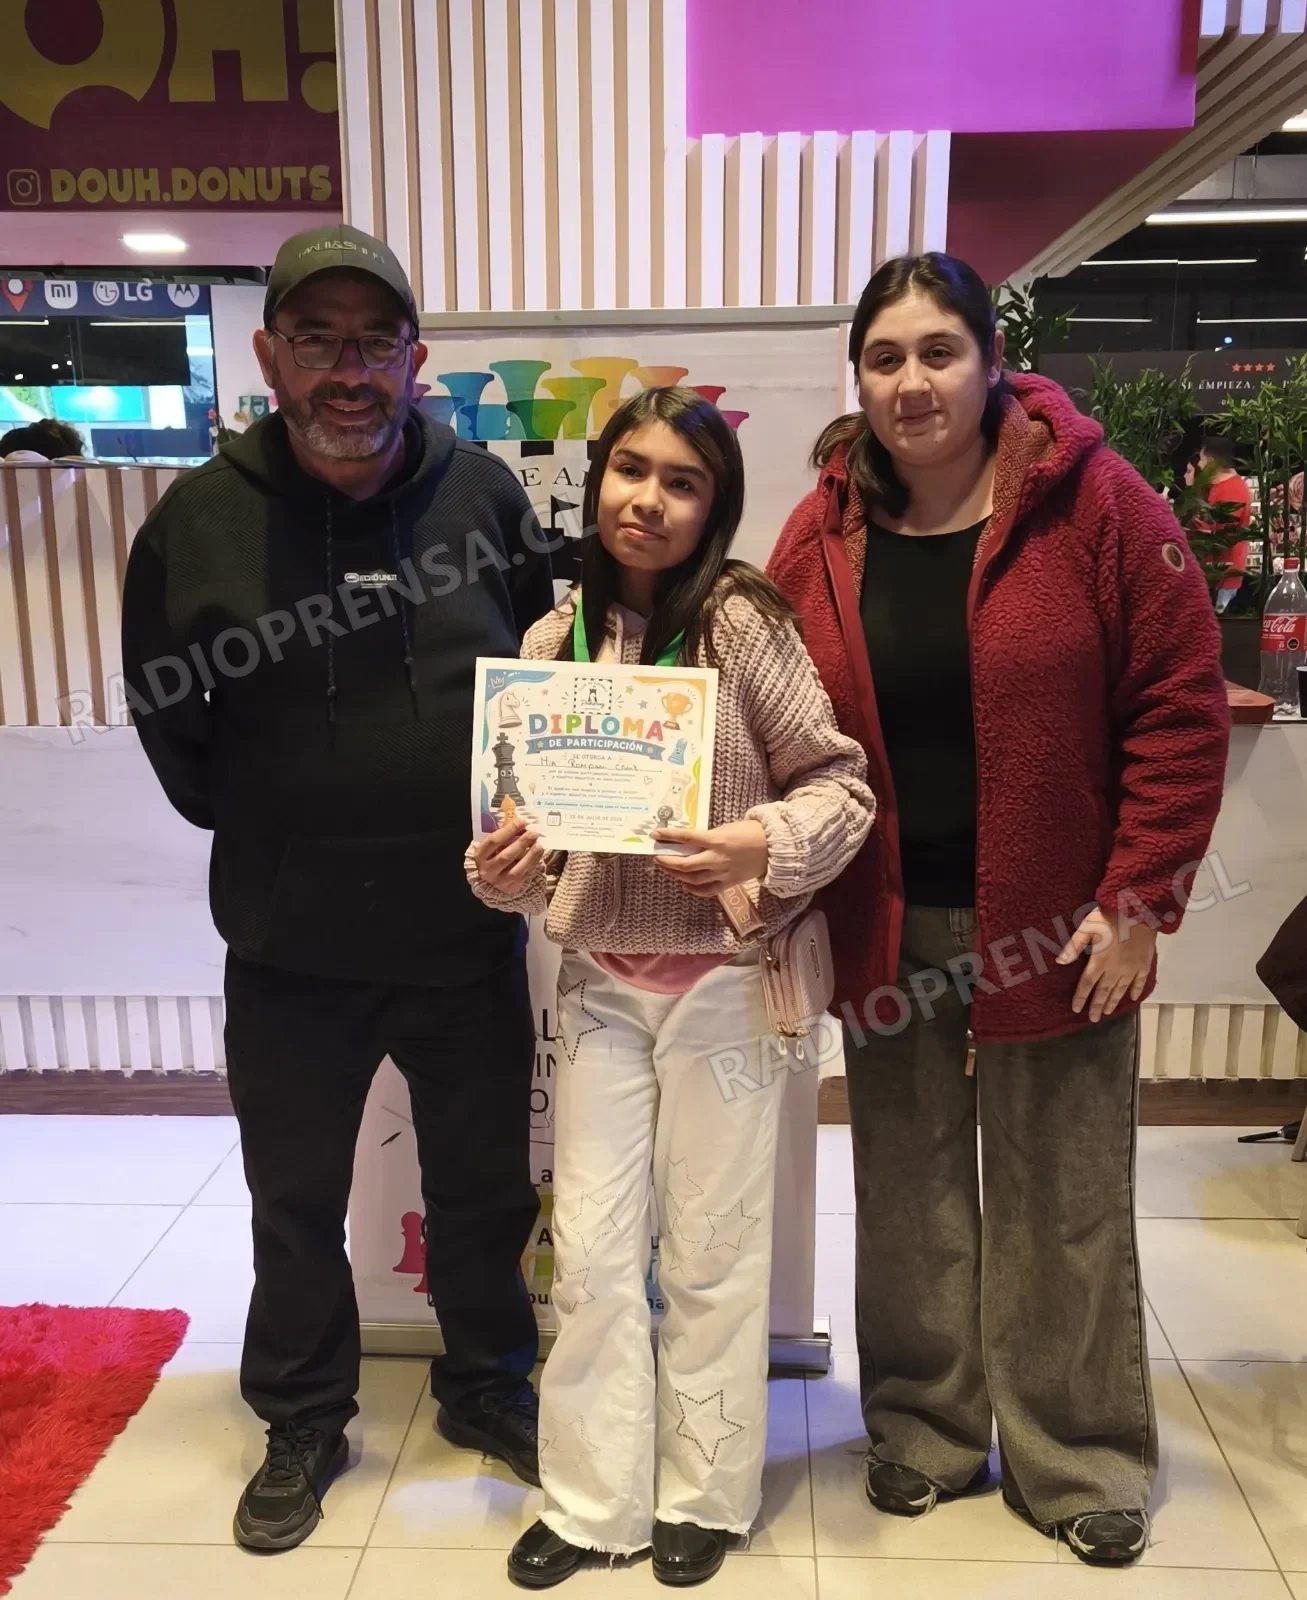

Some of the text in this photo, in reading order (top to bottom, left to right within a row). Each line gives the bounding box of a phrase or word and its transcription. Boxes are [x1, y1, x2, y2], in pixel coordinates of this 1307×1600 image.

[50, 165, 332, 203] DOUH.DONUTS
[123, 282, 153, 302] LG
[528, 713, 664, 742] DIPLOMA
[548, 738, 643, 752] DE PARTICIPACIÓN
